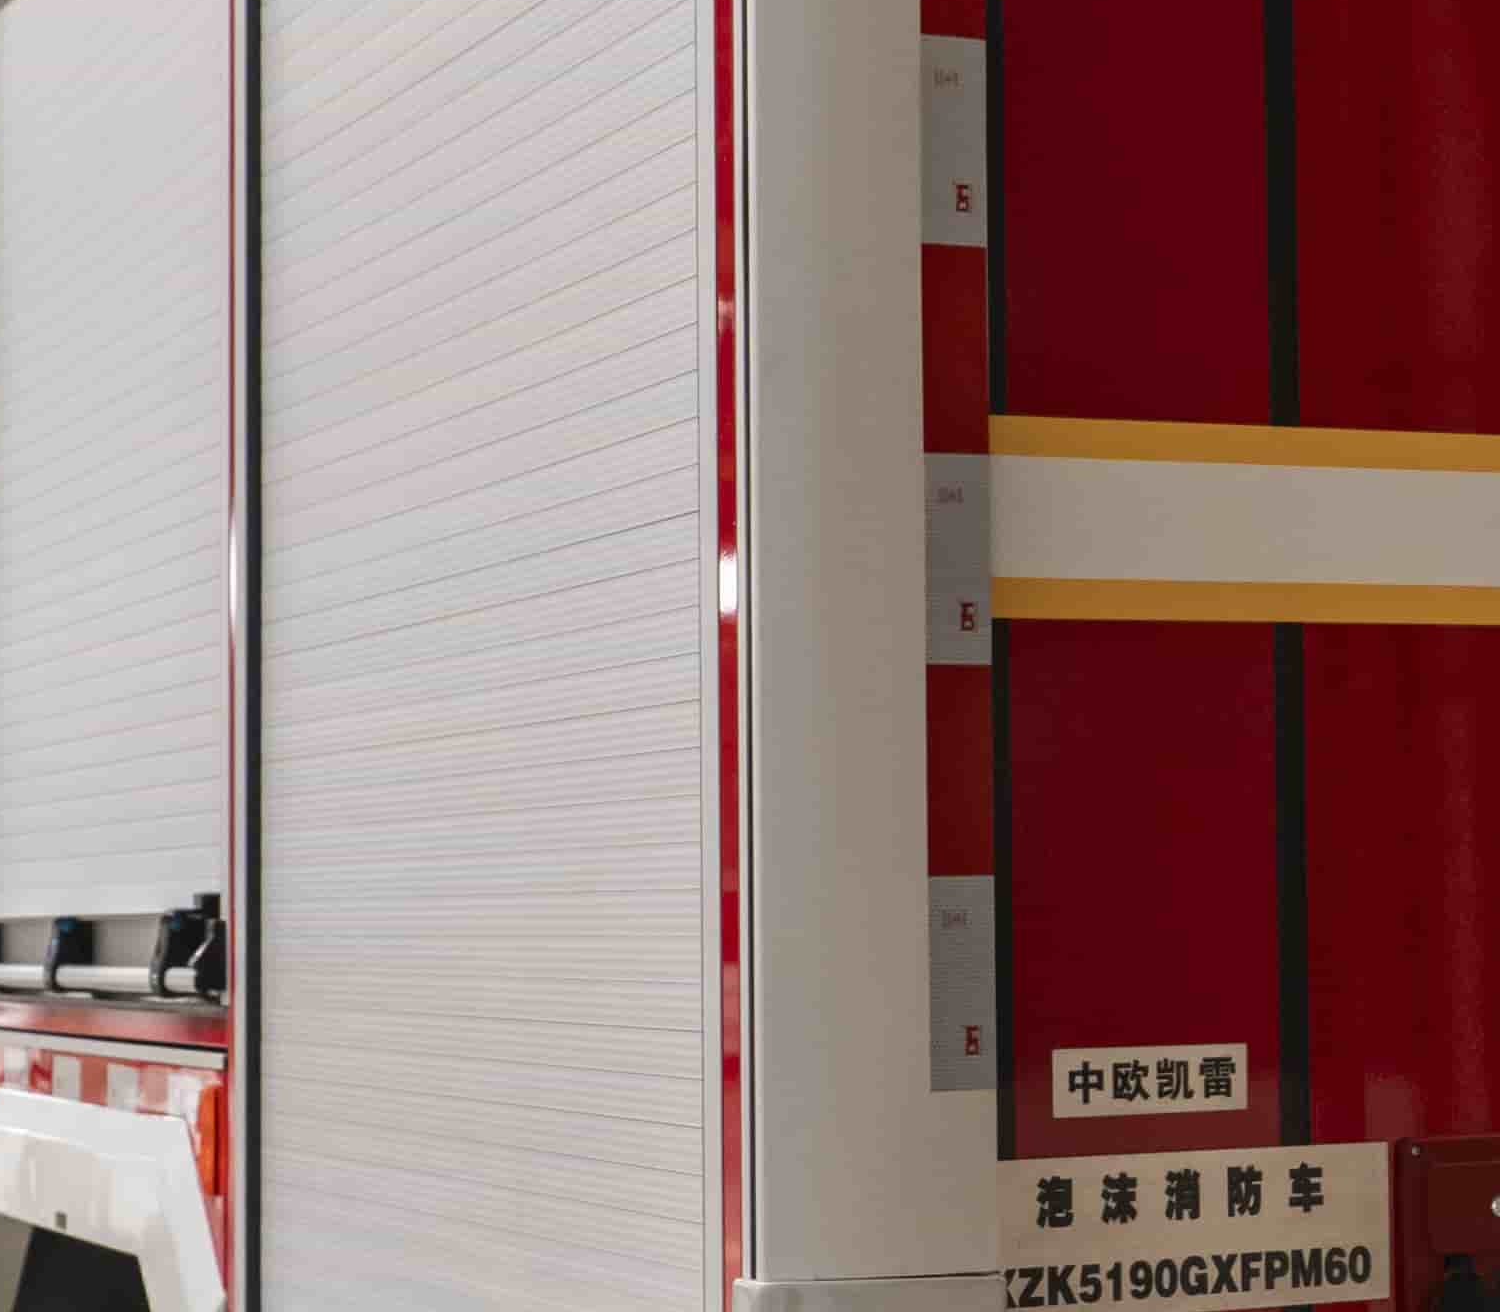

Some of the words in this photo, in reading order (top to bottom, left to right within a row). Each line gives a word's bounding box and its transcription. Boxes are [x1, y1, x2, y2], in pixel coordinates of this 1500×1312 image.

[1067, 1055, 1236, 1104] 中欧凯雷
[1036, 1162, 1325, 1228] 泡沫消防车
